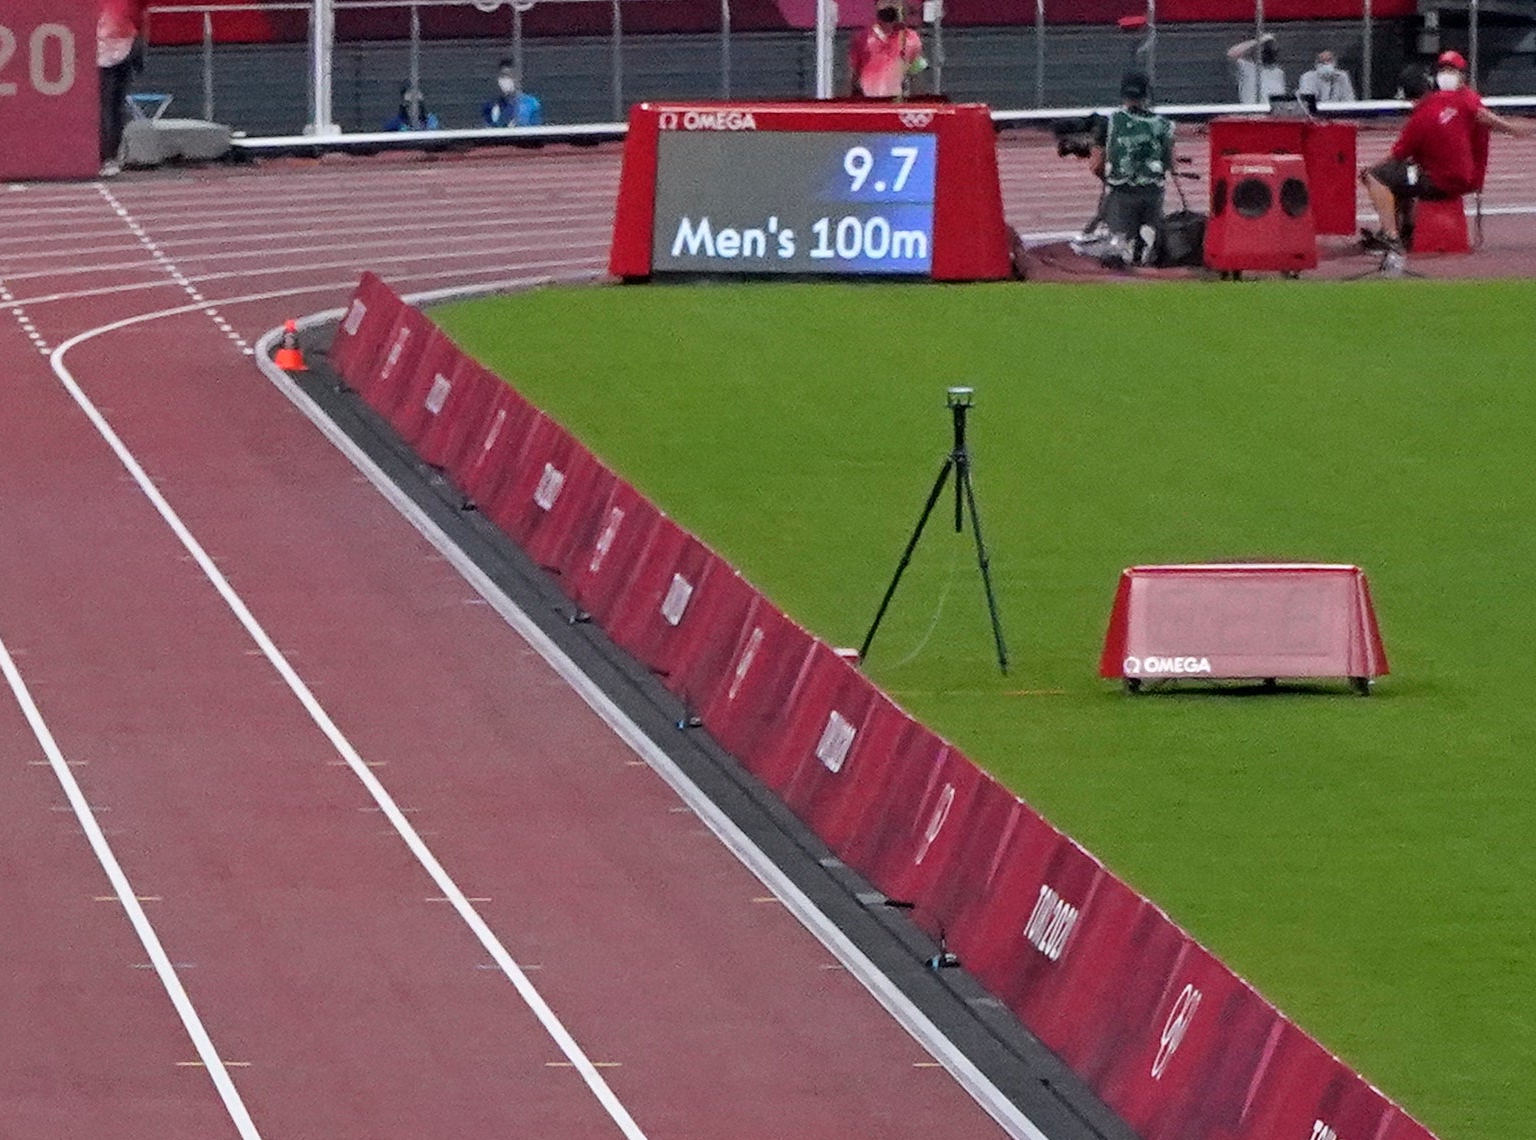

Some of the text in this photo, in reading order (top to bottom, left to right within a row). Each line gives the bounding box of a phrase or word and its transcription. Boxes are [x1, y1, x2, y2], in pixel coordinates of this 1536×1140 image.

[684, 112, 756, 130] OMEGA
[843, 146, 918, 192] 9.7
[671, 215, 927, 259] Men's 100m
[1143, 657, 1211, 673] OMEGA
